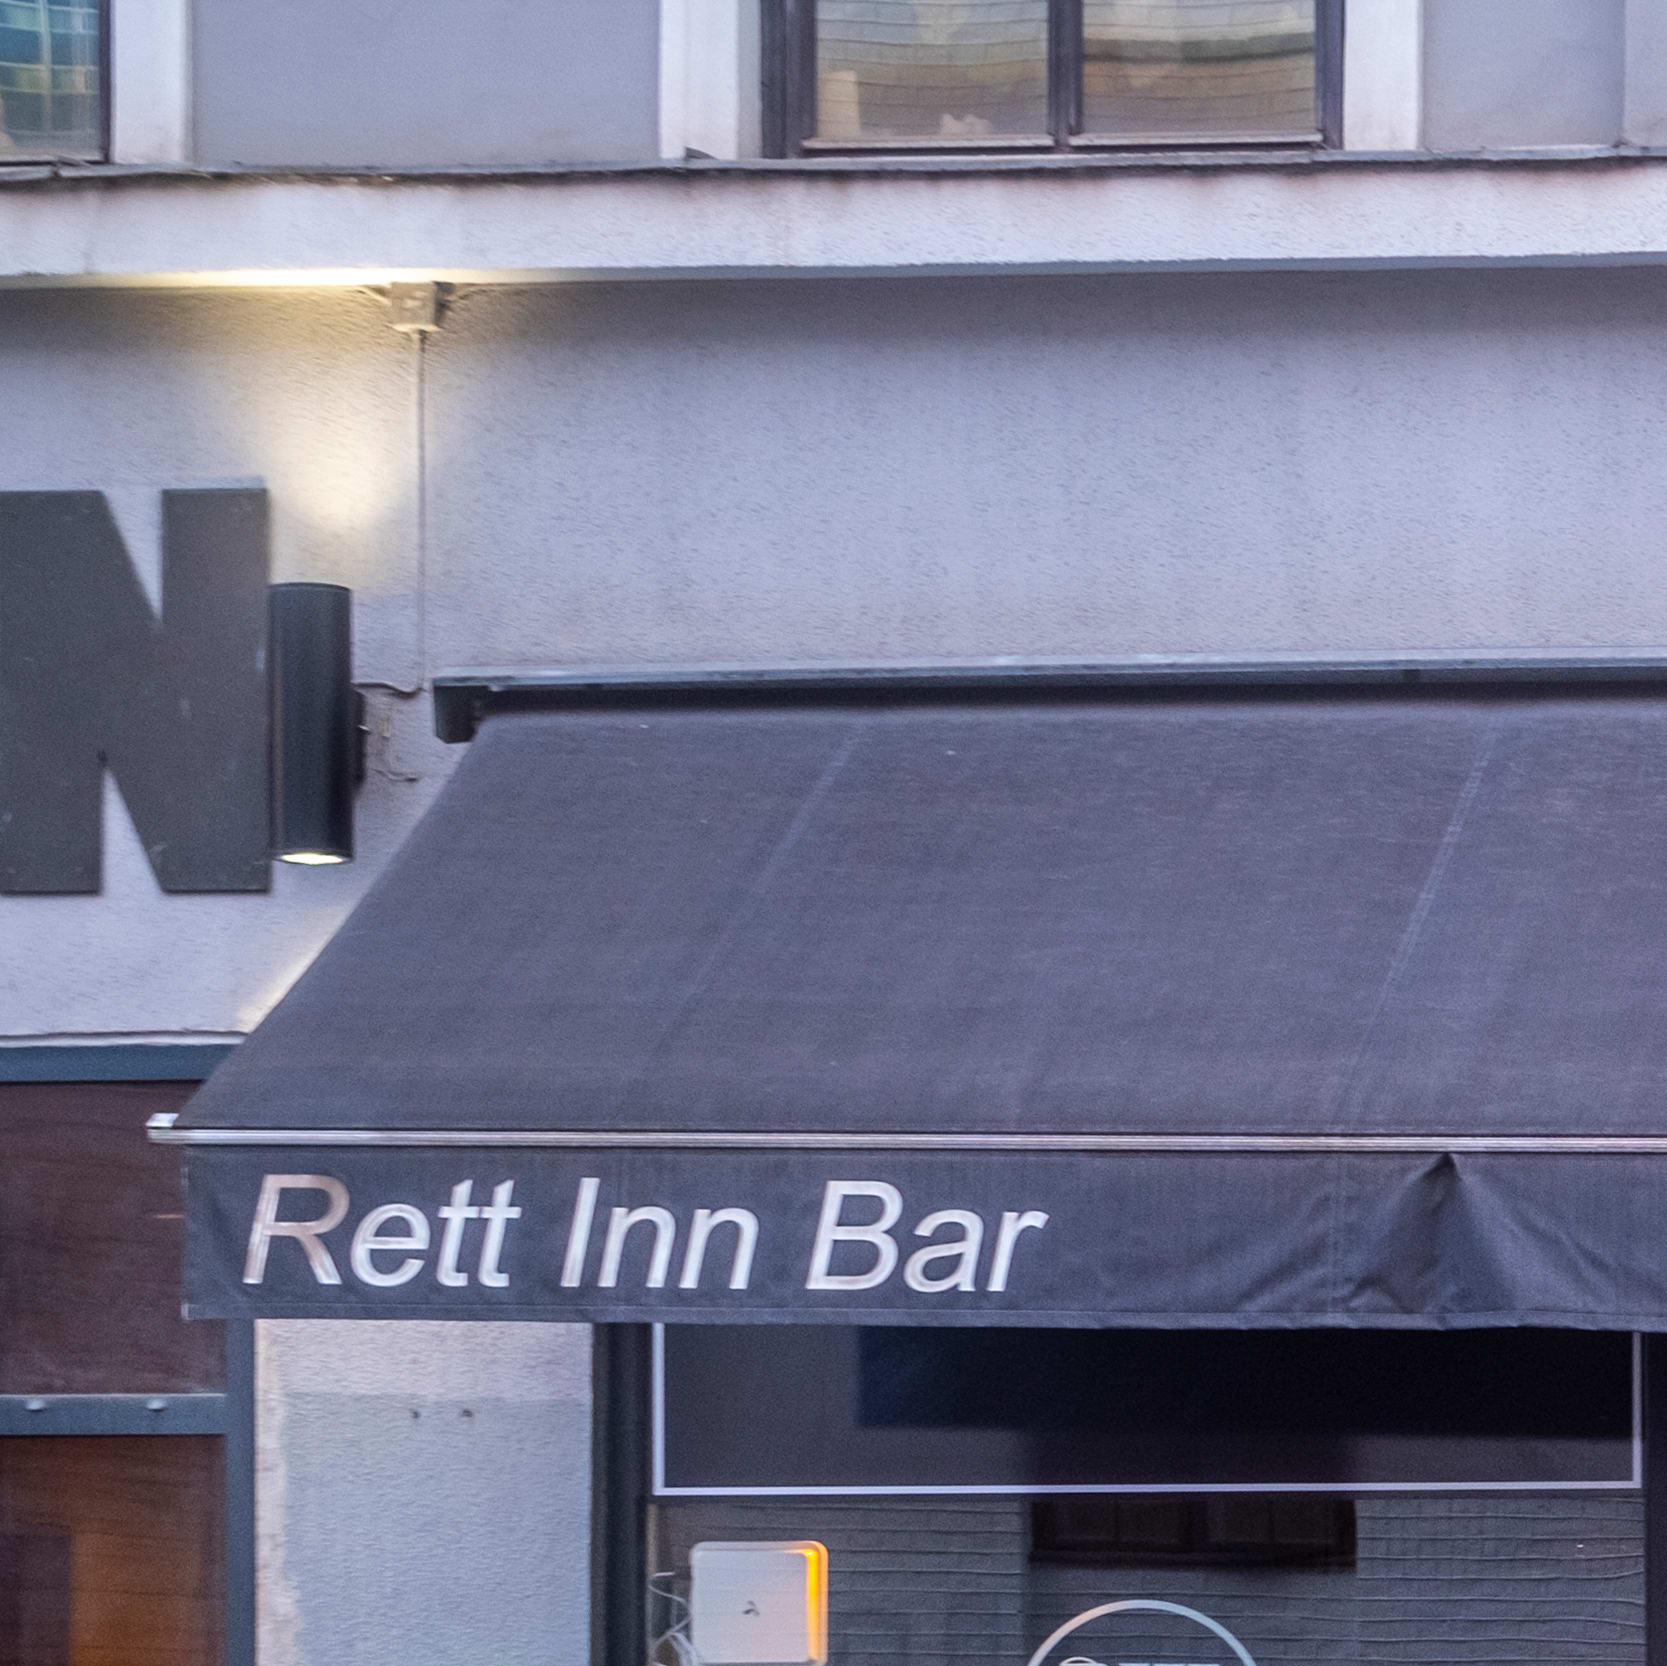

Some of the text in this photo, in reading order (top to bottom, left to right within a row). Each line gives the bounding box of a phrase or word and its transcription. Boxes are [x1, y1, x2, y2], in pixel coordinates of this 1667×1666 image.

[243, 1175, 1050, 1293] Rett Inn Bar
